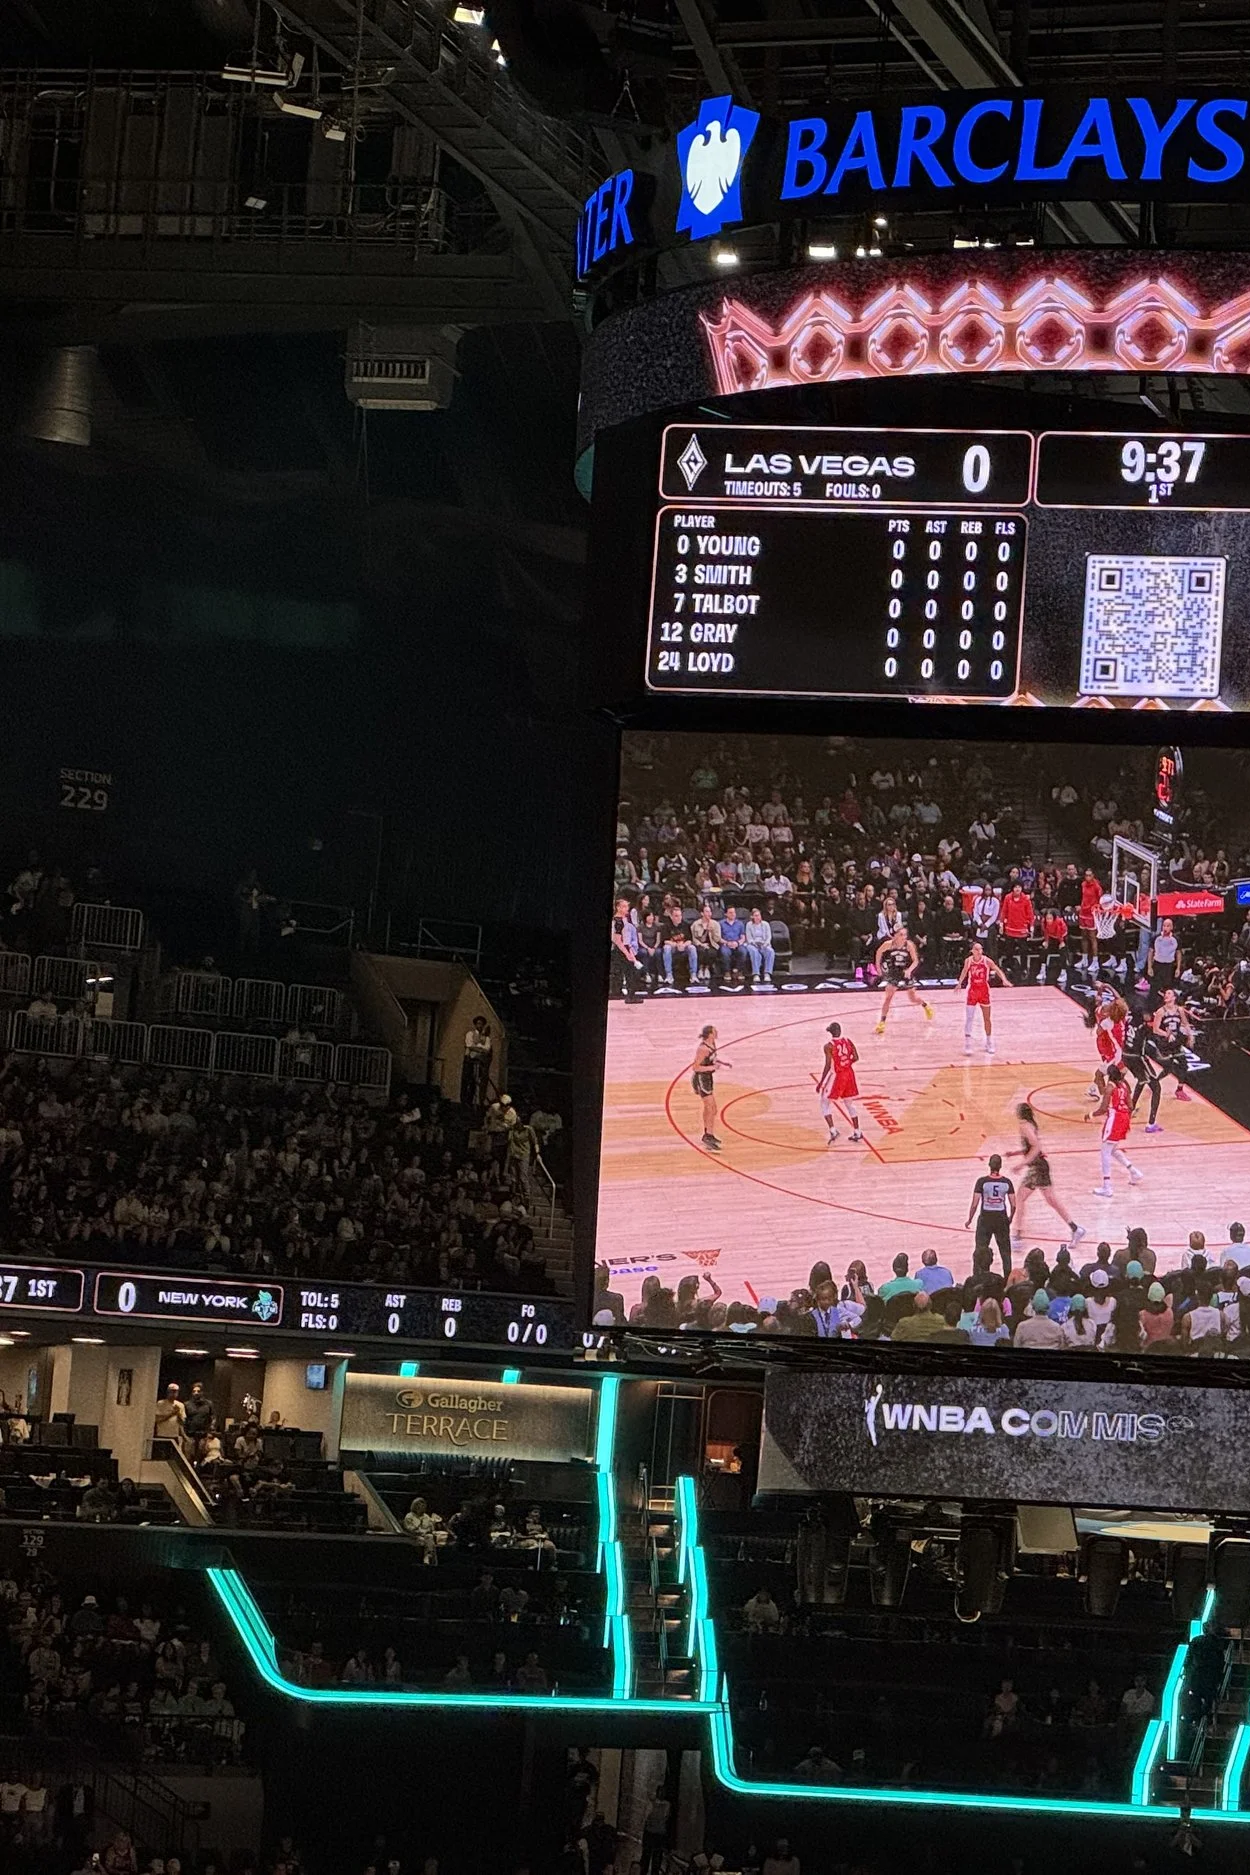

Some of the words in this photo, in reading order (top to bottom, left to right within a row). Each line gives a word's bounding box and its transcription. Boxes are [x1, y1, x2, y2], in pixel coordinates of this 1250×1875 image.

[780, 99, 1247, 200] BARCLAYS
[577, 168, 635, 282] TER
[725, 454, 792, 474] LAS
[799, 455, 914, 477] VEGAS
[963, 445, 990, 492] 0
[1121, 441, 1205, 482] 9:37
[725, 481, 790, 496] TIMEOUTS:
[793, 482, 801, 496] 5
[826, 483, 869, 498] FOULS:
[872, 484, 880, 498] 0
[1149, 483, 1174, 503] 1ST
[674, 515, 715, 528] PLAYER
[888, 520, 909, 532] PTS
[926, 521, 947, 533] AST
[961, 521, 982, 534] REB
[995, 522, 1015, 535] FLS
[677, 535, 689, 554] 0
[697, 535, 760, 556] YOUNG
[893, 540, 904, 559] 0
[929, 541, 940, 560] 0
[966, 542, 977, 561] 0
[998, 542, 1010, 561] 0
[675, 564, 687, 583] 3
[694, 564, 751, 584] SMITH
[891, 569, 902, 588] 0
[927, 570, 939, 589] 0
[964, 571, 975, 590] 0
[997, 572, 1008, 591] 0
[674, 593, 685, 612] 7
[692, 594, 760, 614] TALBOT
[889, 599, 901, 618] 0
[925, 599, 937, 619] 0
[962, 600, 973, 620] 0
[995, 601, 1006, 620] 0
[661, 622, 683, 641] 12
[690, 623, 738, 643] GRAY
[887, 628, 898, 647] 0
[923, 629, 934, 648] 0
[960, 630, 971, 649] 0
[993, 631, 1004, 650] 0
[658, 651, 680, 671] 24
[688, 652, 733, 672] LOYD
[885, 658, 896, 677] 0
[921, 659, 933, 678] 0
[958, 660, 969, 679] 0
[991, 661, 1002, 679] 0
[60, 768, 112, 785] SECTION
[60, 785, 109, 811] 229
[862, 1101, 904, 1135] WNBA
[28, 1279, 56, 1297] 1ST
[119, 1282, 136, 1312] 0
[159, 1292, 199, 1304] NEW
[202, 1295, 247, 1308] YORK
[301, 1292, 328, 1307] TOL:
[331, 1294, 339, 1308] 5
[385, 1294, 406, 1307] AST
[442, 1298, 461, 1312] REB
[522, 1305, 535, 1317] FG
[301, 1313, 326, 1328] FLS:
[329, 1315, 337, 1329] 0
[388, 1313, 399, 1333] 0
[445, 1318, 455, 1337] 0
[427, 1392, 503, 1413] Gallagher
[385, 1412, 509, 1446] TERRACE
[882, 1403, 996, 1434] WNBA
